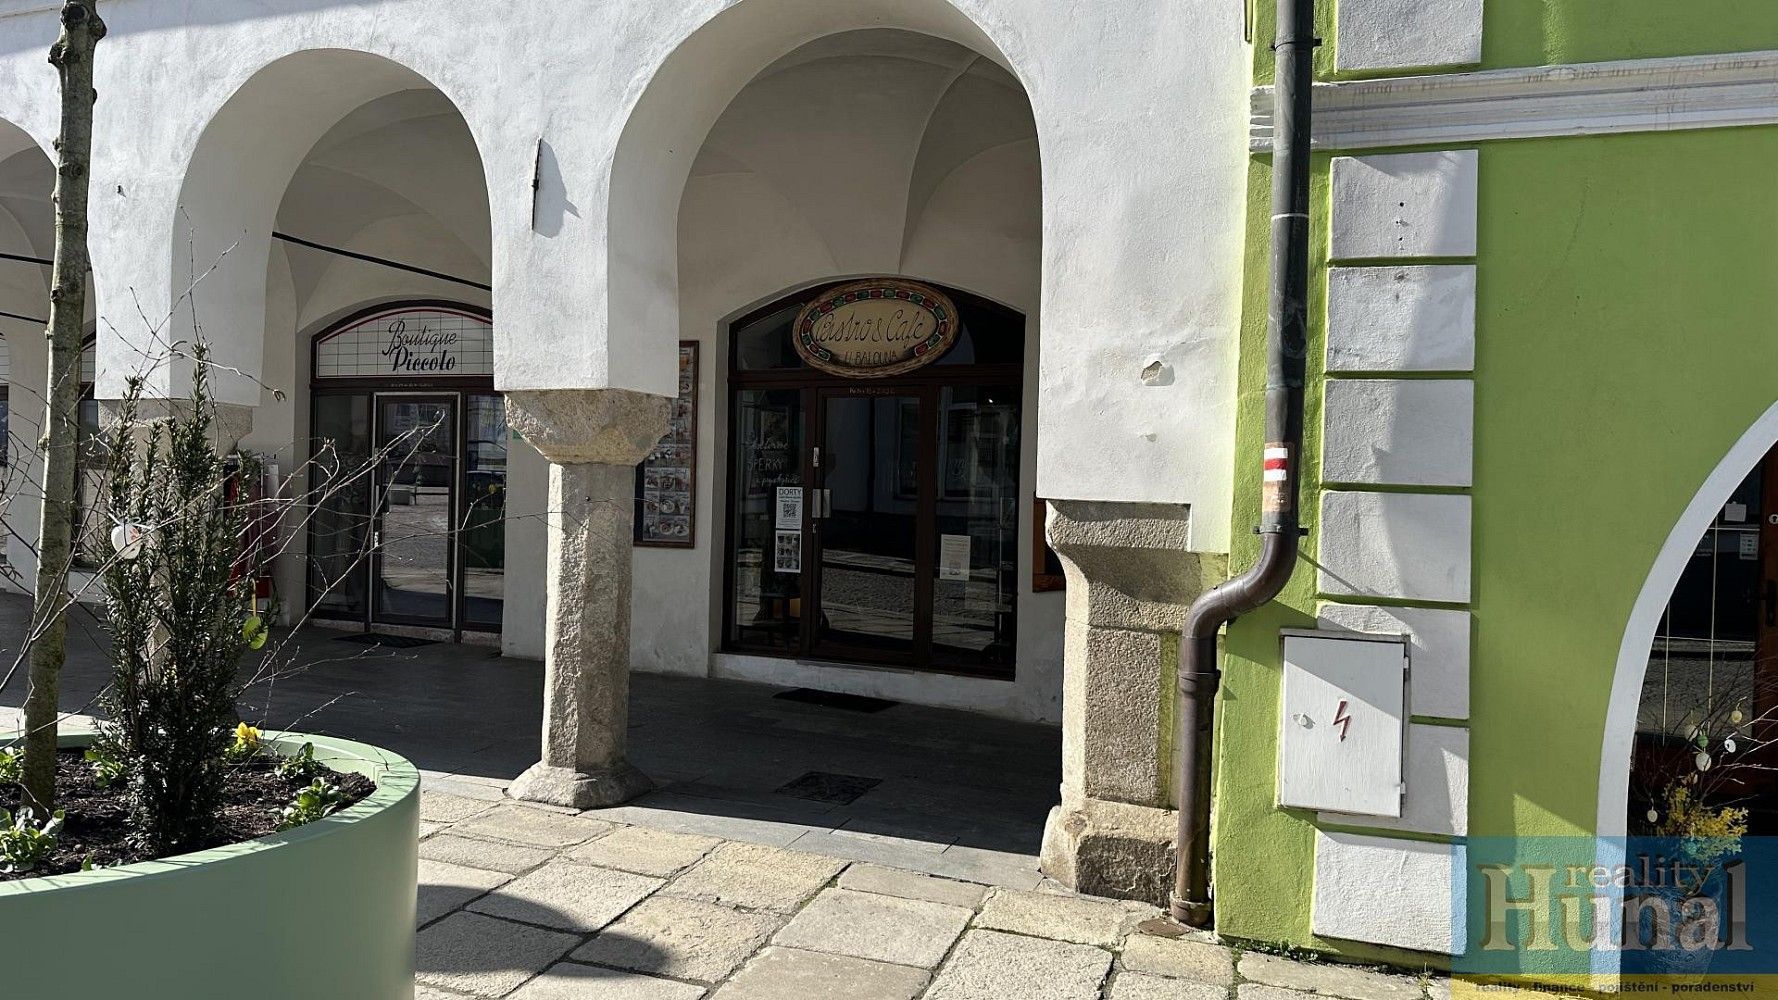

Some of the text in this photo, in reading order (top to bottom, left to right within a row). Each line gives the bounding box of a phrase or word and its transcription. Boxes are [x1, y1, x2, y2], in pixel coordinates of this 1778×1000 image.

[382, 319, 457, 355] Boutique
[389, 347, 456, 371] Piccolo
[779, 487, 802, 497] DORTY
